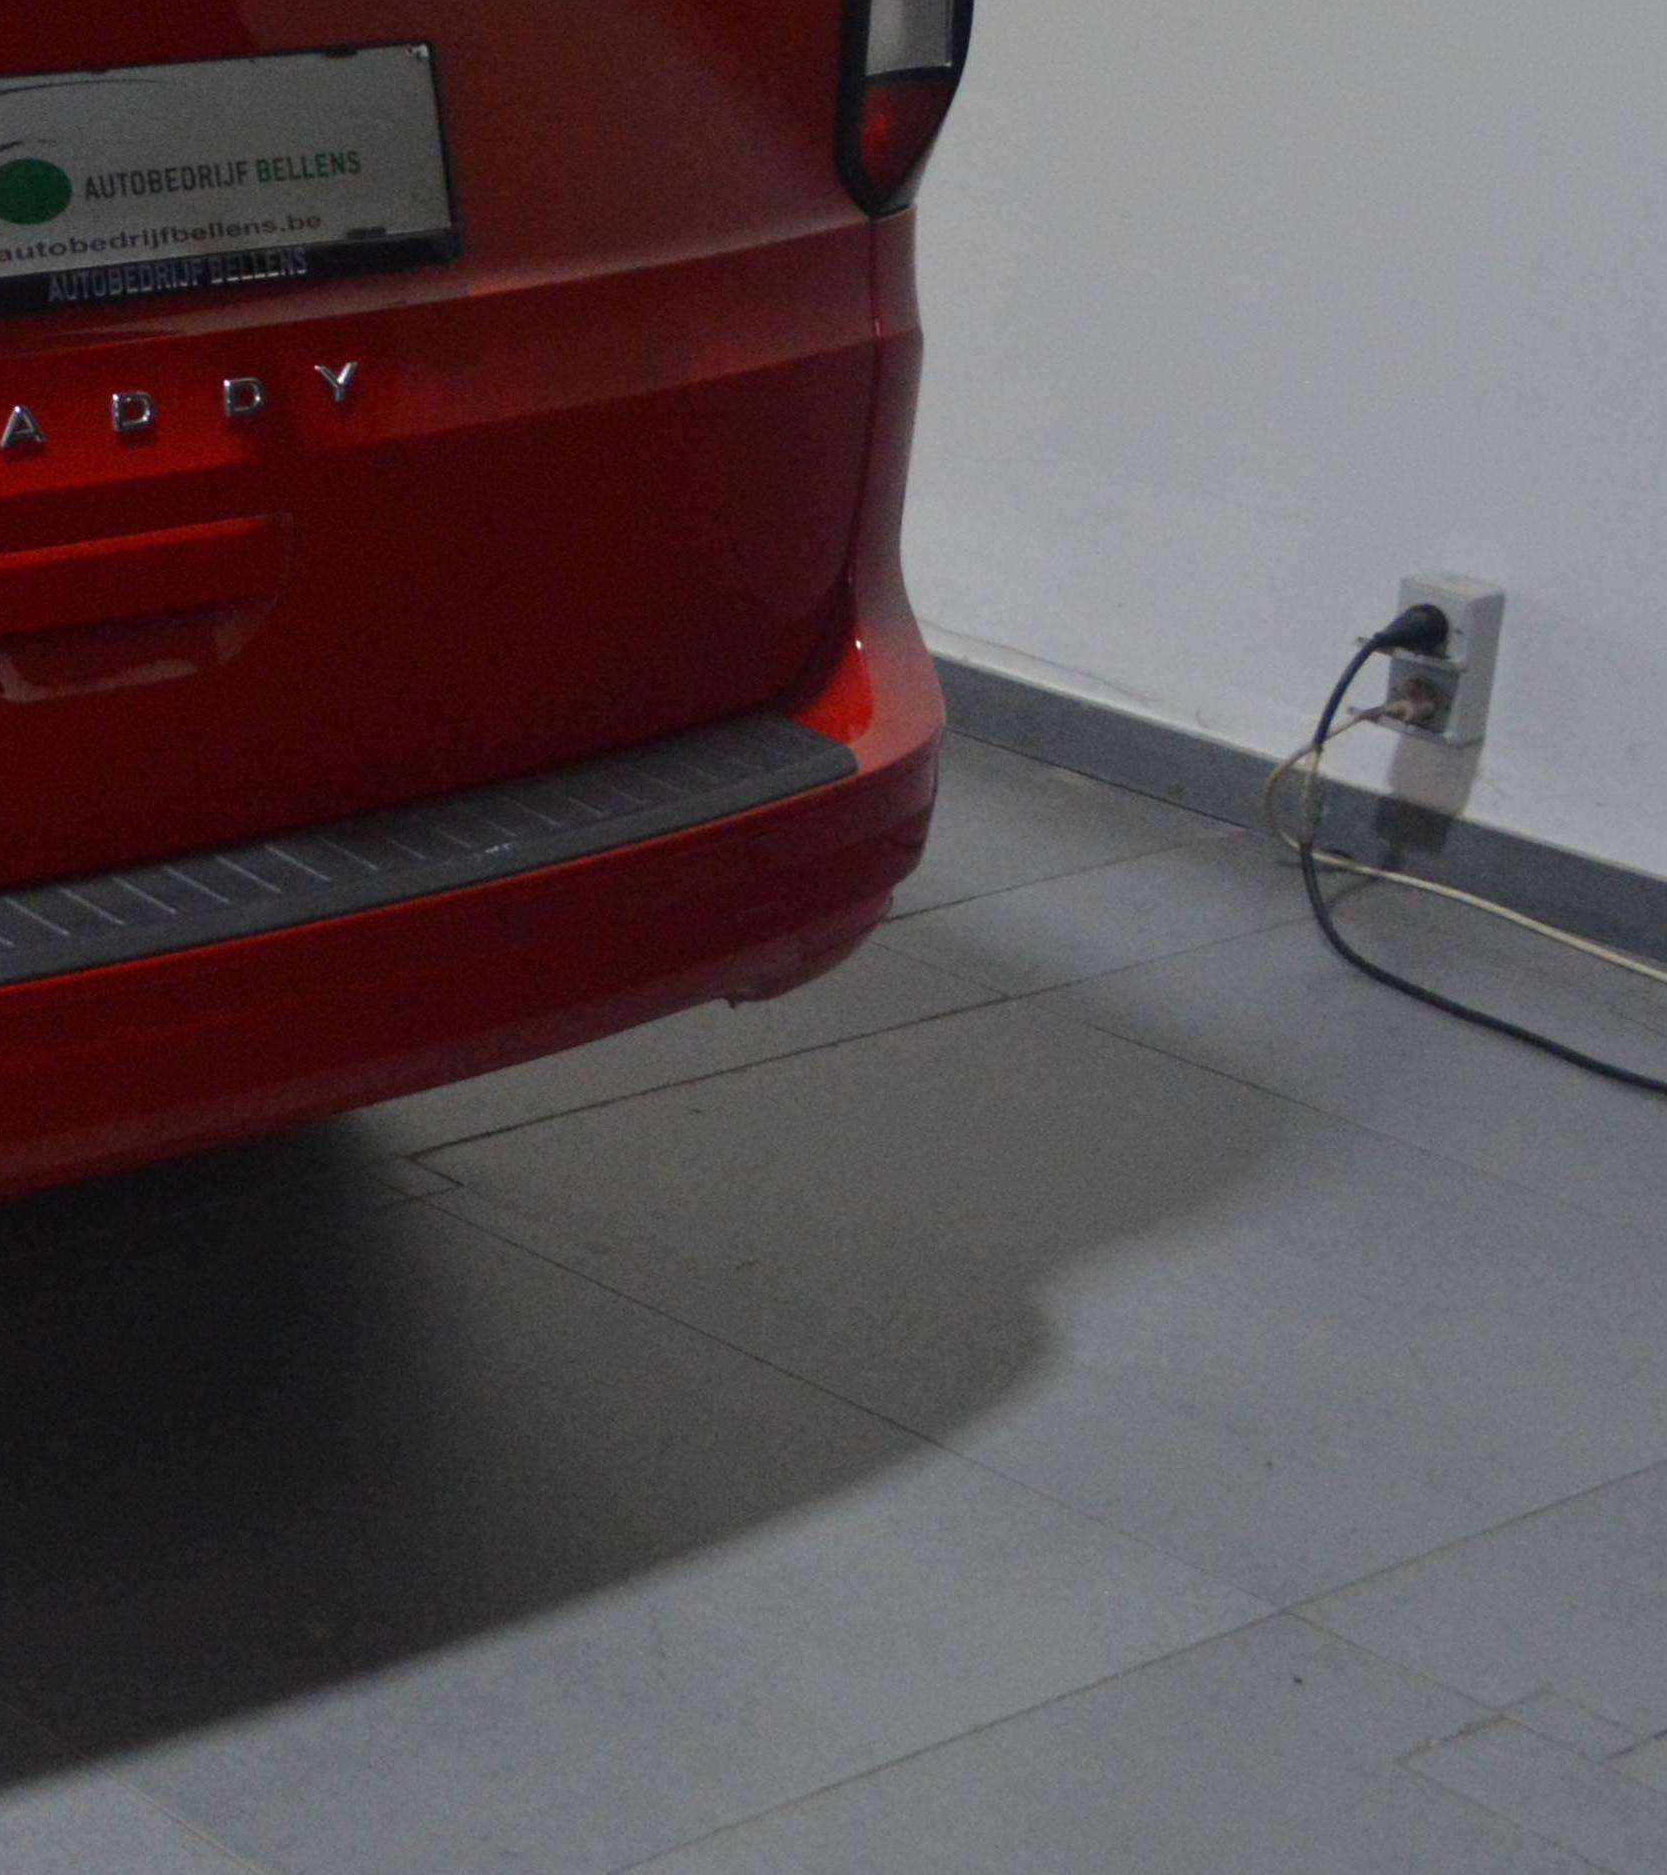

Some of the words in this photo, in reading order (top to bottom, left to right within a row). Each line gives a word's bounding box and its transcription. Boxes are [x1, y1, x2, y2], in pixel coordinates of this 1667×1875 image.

[84, 160, 248, 201] AUTOBEDRIJF
[255, 150, 362, 184] BELLENS
[47, 256, 201, 303] AUTOBEDRIJF
